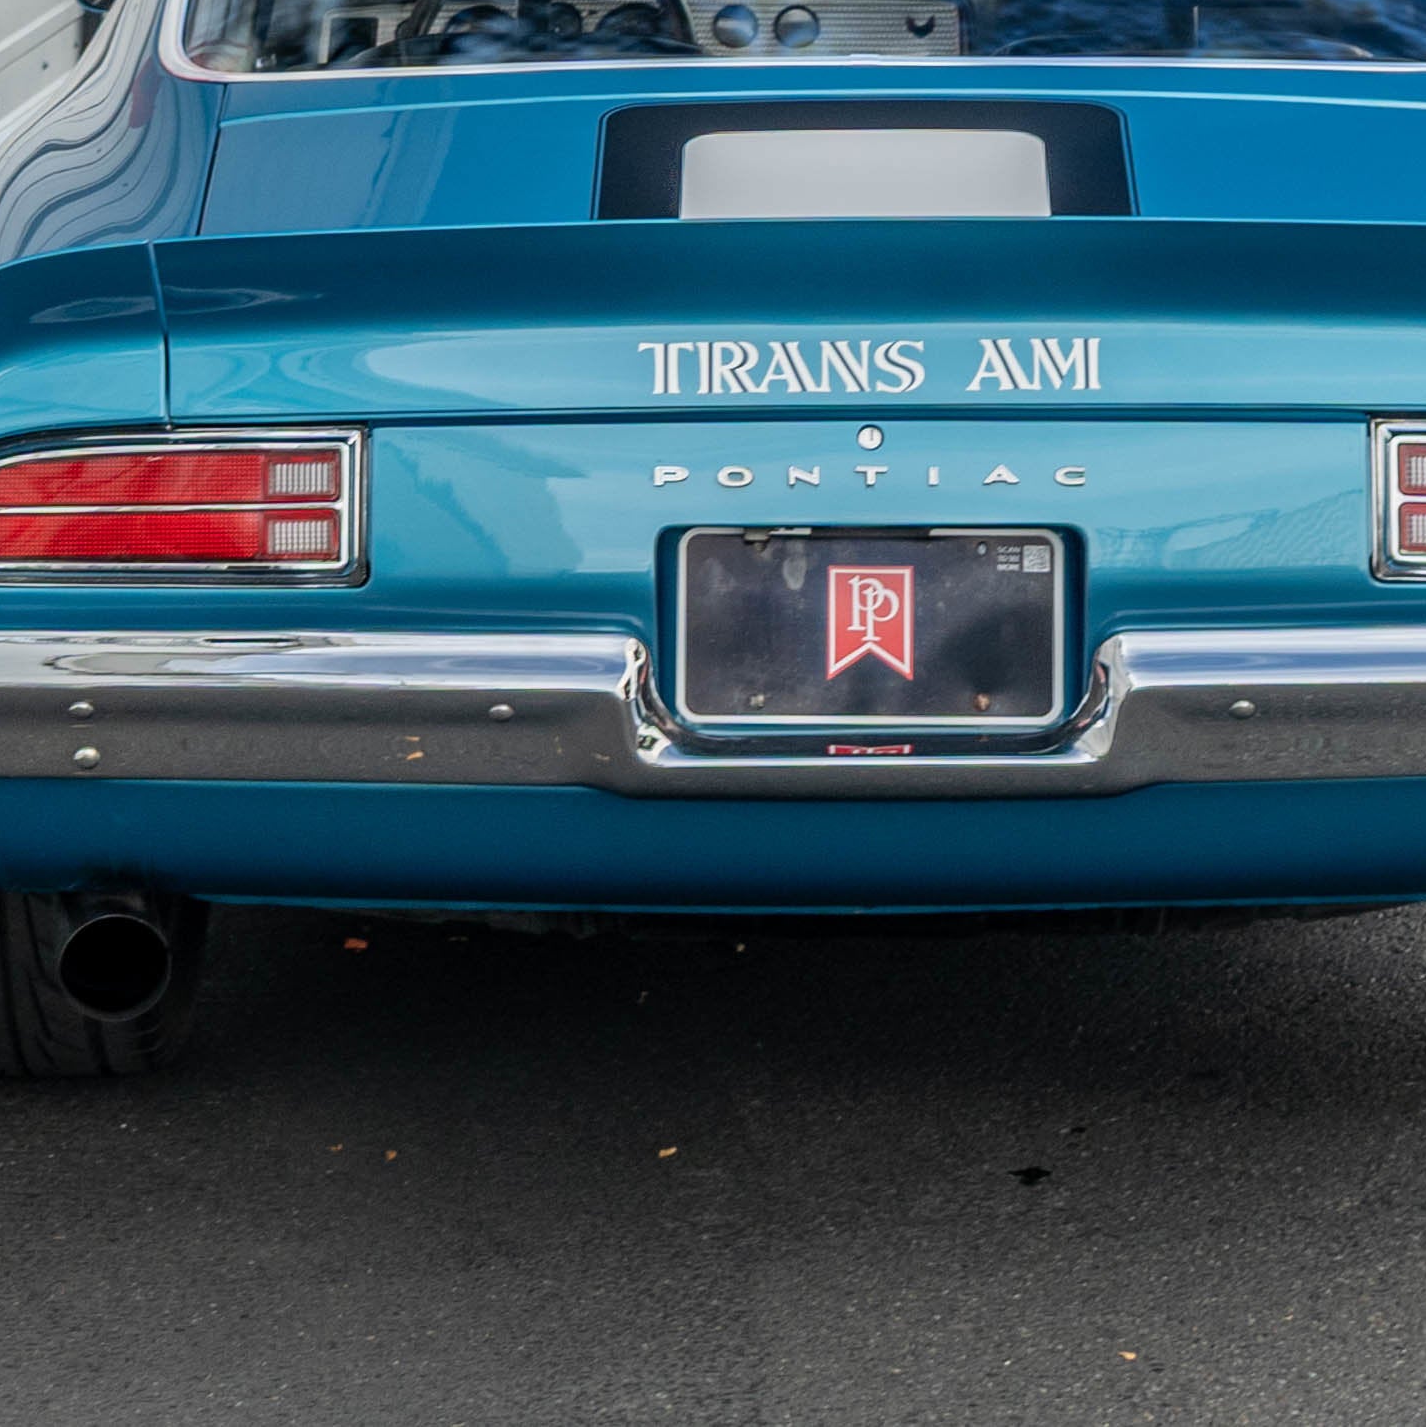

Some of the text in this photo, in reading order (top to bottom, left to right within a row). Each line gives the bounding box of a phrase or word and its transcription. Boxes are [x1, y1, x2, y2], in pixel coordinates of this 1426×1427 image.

[637, 337, 1102, 395] TRANS AM
[652, 463, 1087, 488] PONTIAC
